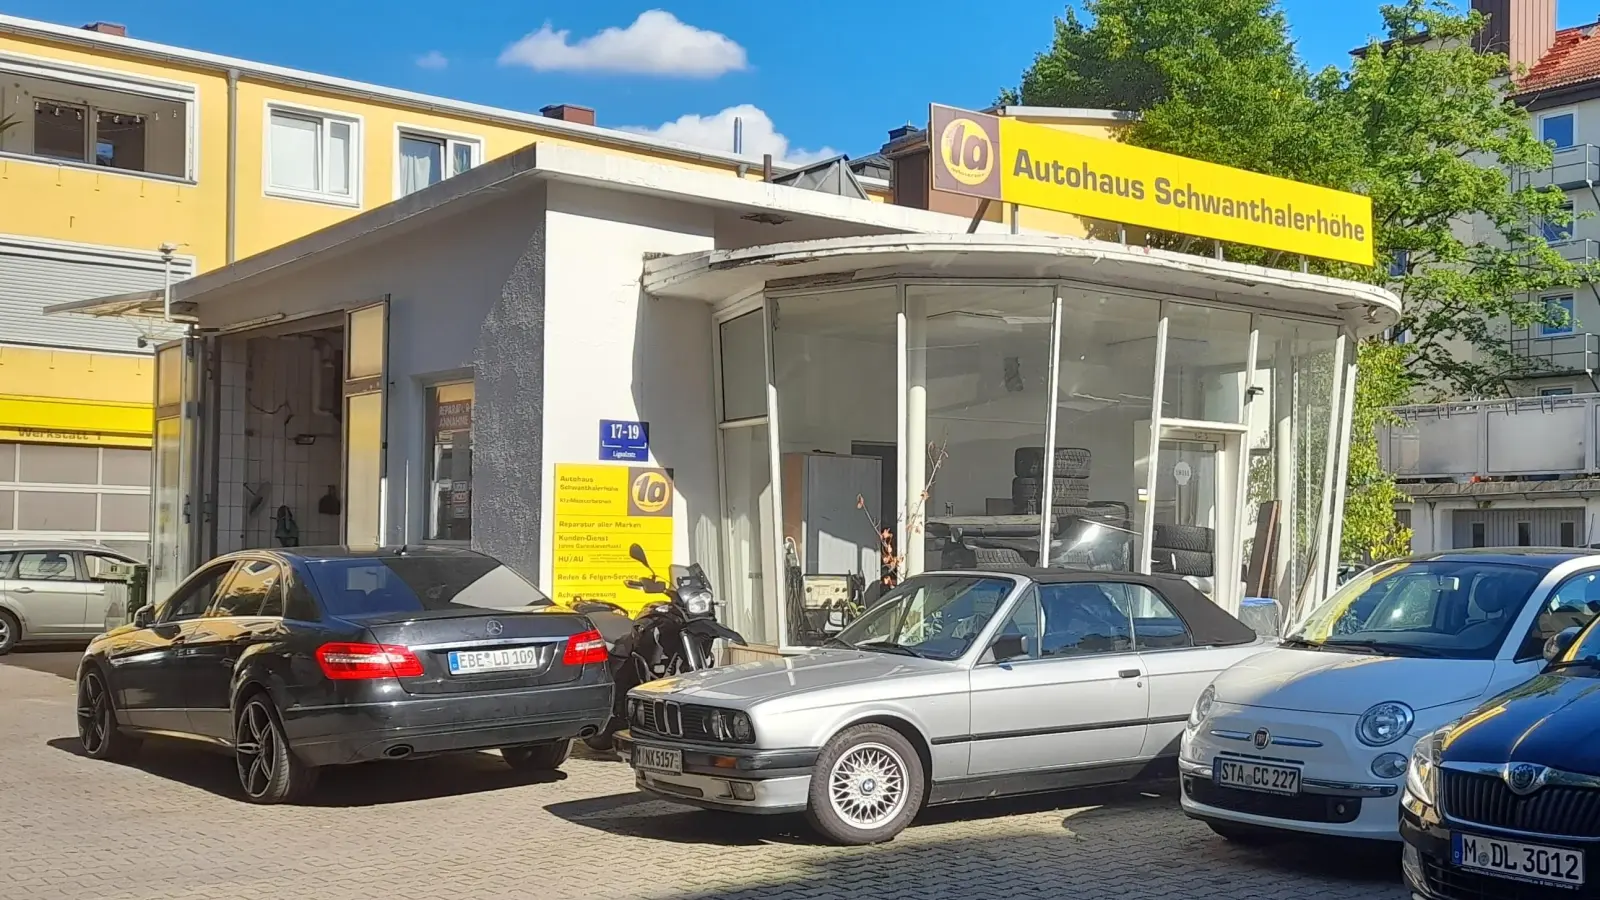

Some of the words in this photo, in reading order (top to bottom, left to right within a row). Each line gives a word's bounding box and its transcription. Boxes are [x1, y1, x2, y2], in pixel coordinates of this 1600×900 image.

[1013, 148, 1145, 200] Autohaus
[1154, 177, 1366, 242] Schwanthalerhöhe
[18, 426, 89, 440] Werkstatt
[610, 423, 639, 440] 17-19
[560, 475, 594, 483] Autohaus
[636, 475, 666, 503] 1a
[559, 520, 596, 529] Reparatur
[597, 520, 613, 528] aller
[614, 521, 641, 529] Marken
[558, 534, 609, 542] Kunden-Dienst
[558, 555, 584, 563] HU/AU
[557, 573, 580, 581] Reifen
[589, 573, 639, 582] Felgen-Service
[459, 654, 485, 669] EBE
[493, 651, 510, 667] LD
[511, 649, 535, 665] 109
[645, 748, 655, 767] NX
[655, 750, 674, 768] 5157
[1221, 762, 1244, 783] STA
[1253, 766, 1269, 786] CC
[1271, 769, 1297, 790] 227
[1463, 838, 1477, 863] M
[1490, 842, 1518, 870] DL
[1522, 847, 1580, 881] 3012
